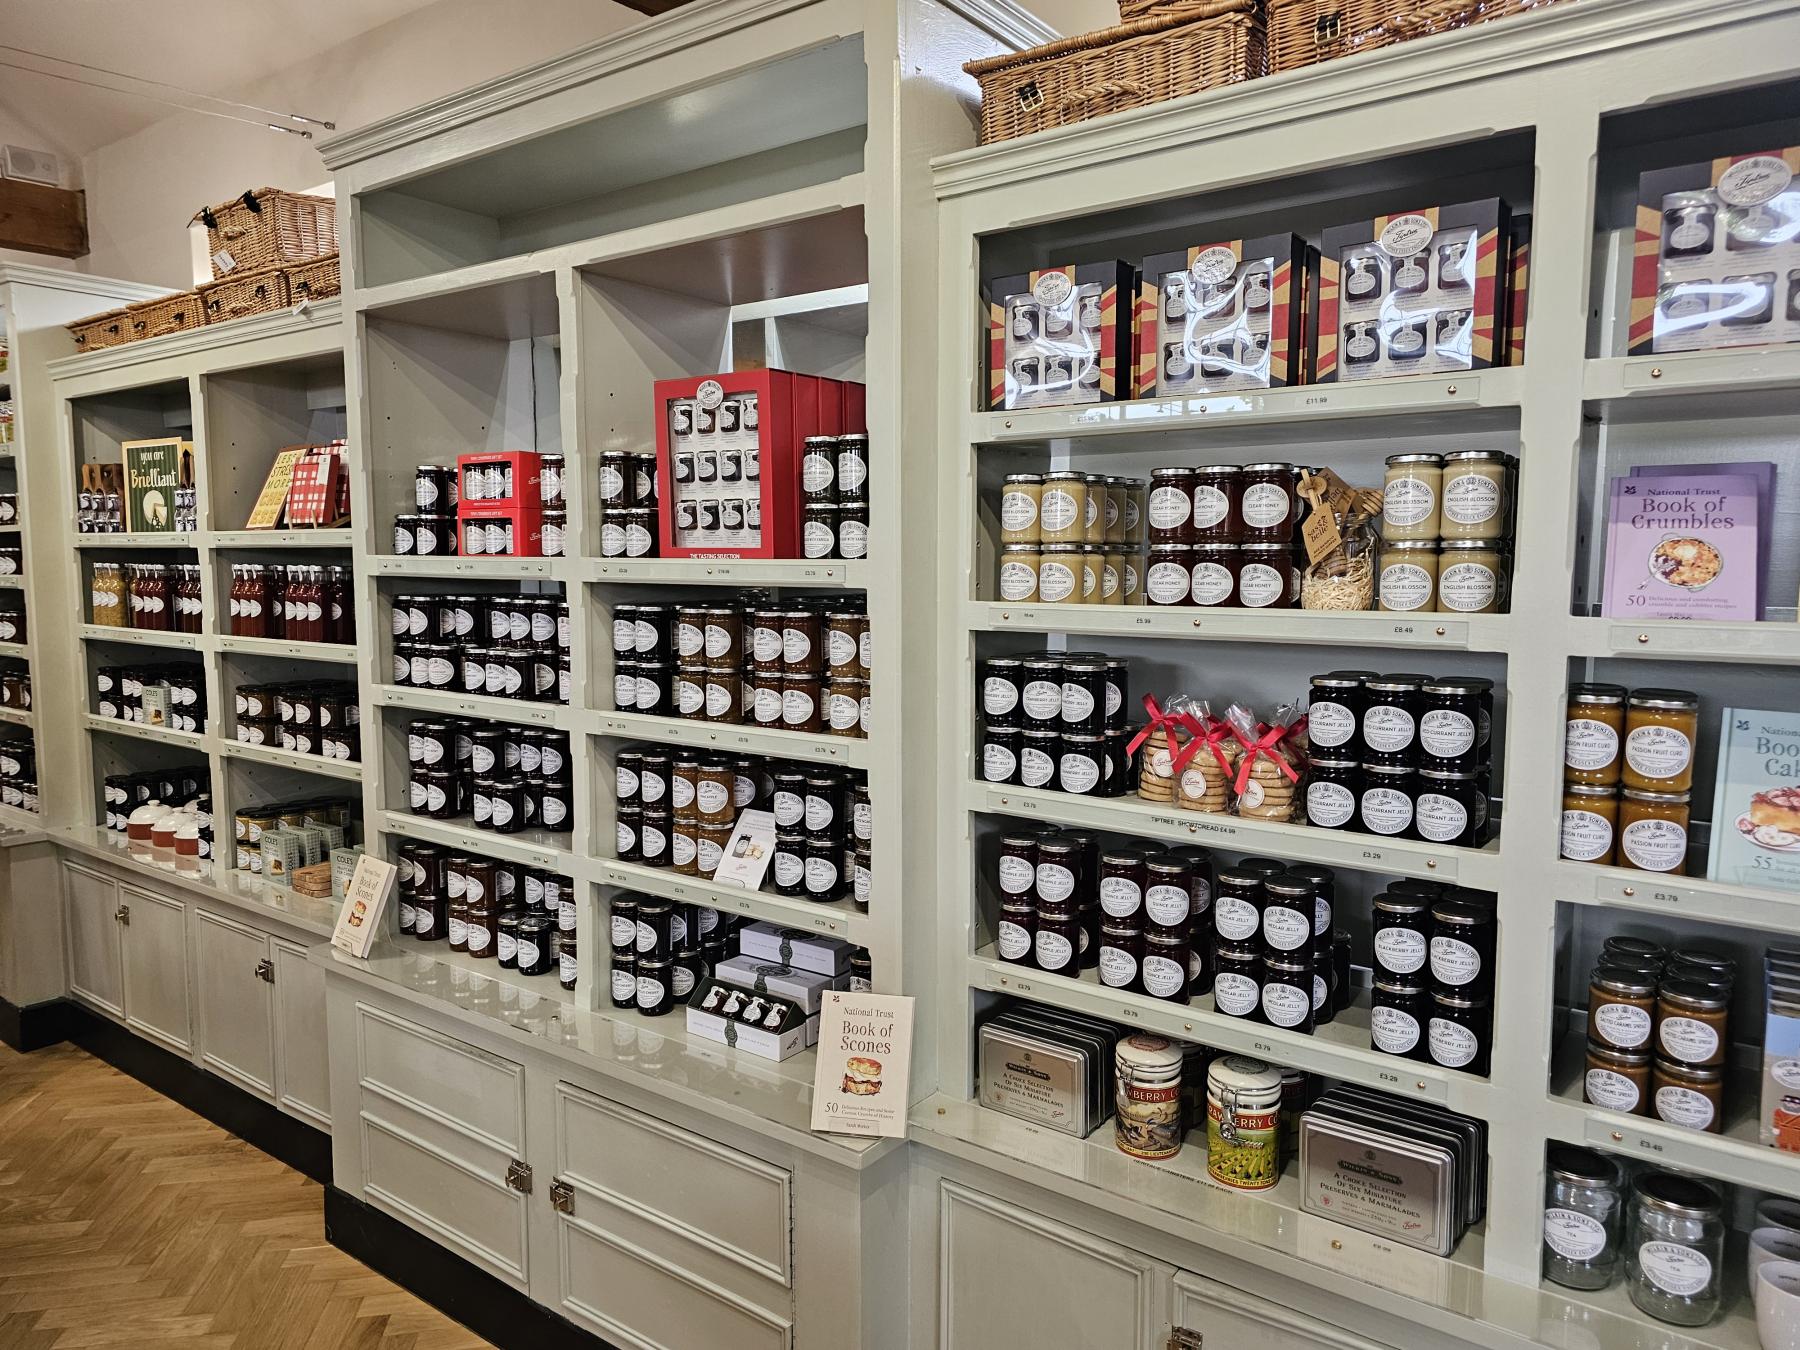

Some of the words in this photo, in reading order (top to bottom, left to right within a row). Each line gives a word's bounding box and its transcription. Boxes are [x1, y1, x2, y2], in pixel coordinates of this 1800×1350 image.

[141, 452, 152, 464] you
[154, 452, 164, 460] are
[131, 468, 177, 488] Brielliant
[1642, 498, 1698, 513] Book
[1704, 497, 1727, 513] of
[1631, 514, 1734, 529] Crumbles
[1626, 595, 1646, 606] 50
[1152, 817, 1174, 825] TIPTREE
[1423, 813, 1446, 821] CURRANT
[1631, 840, 1652, 848] PASSION
[1752, 856, 1773, 869] 55
[844, 1007, 873, 1017] National
[875, 1009, 894, 1018] Trust
[843, 1021, 876, 1036] Book
[880, 1024, 893, 1037] of
[840, 1036, 891, 1054] Scones
[1009, 1074, 1025, 1083] CHOICE
[1027, 1080, 1054, 1092] SELECTION
[993, 1082, 1020, 1094] PRESERVES
[1028, 1092, 1064, 1108] MARMALADES
[825, 1102, 839, 1113] 50
[1342, 1175, 1366, 1186] CHOICE
[1369, 1182, 1406, 1199] SELECTION
[1349, 1184, 1361, 1193] SIX
[1364, 1188, 1402, 1204] MINIATURE
[1320, 1182, 1358, 1200] PRESERVES
[1368, 1198, 1421, 1218] MARMALADES
